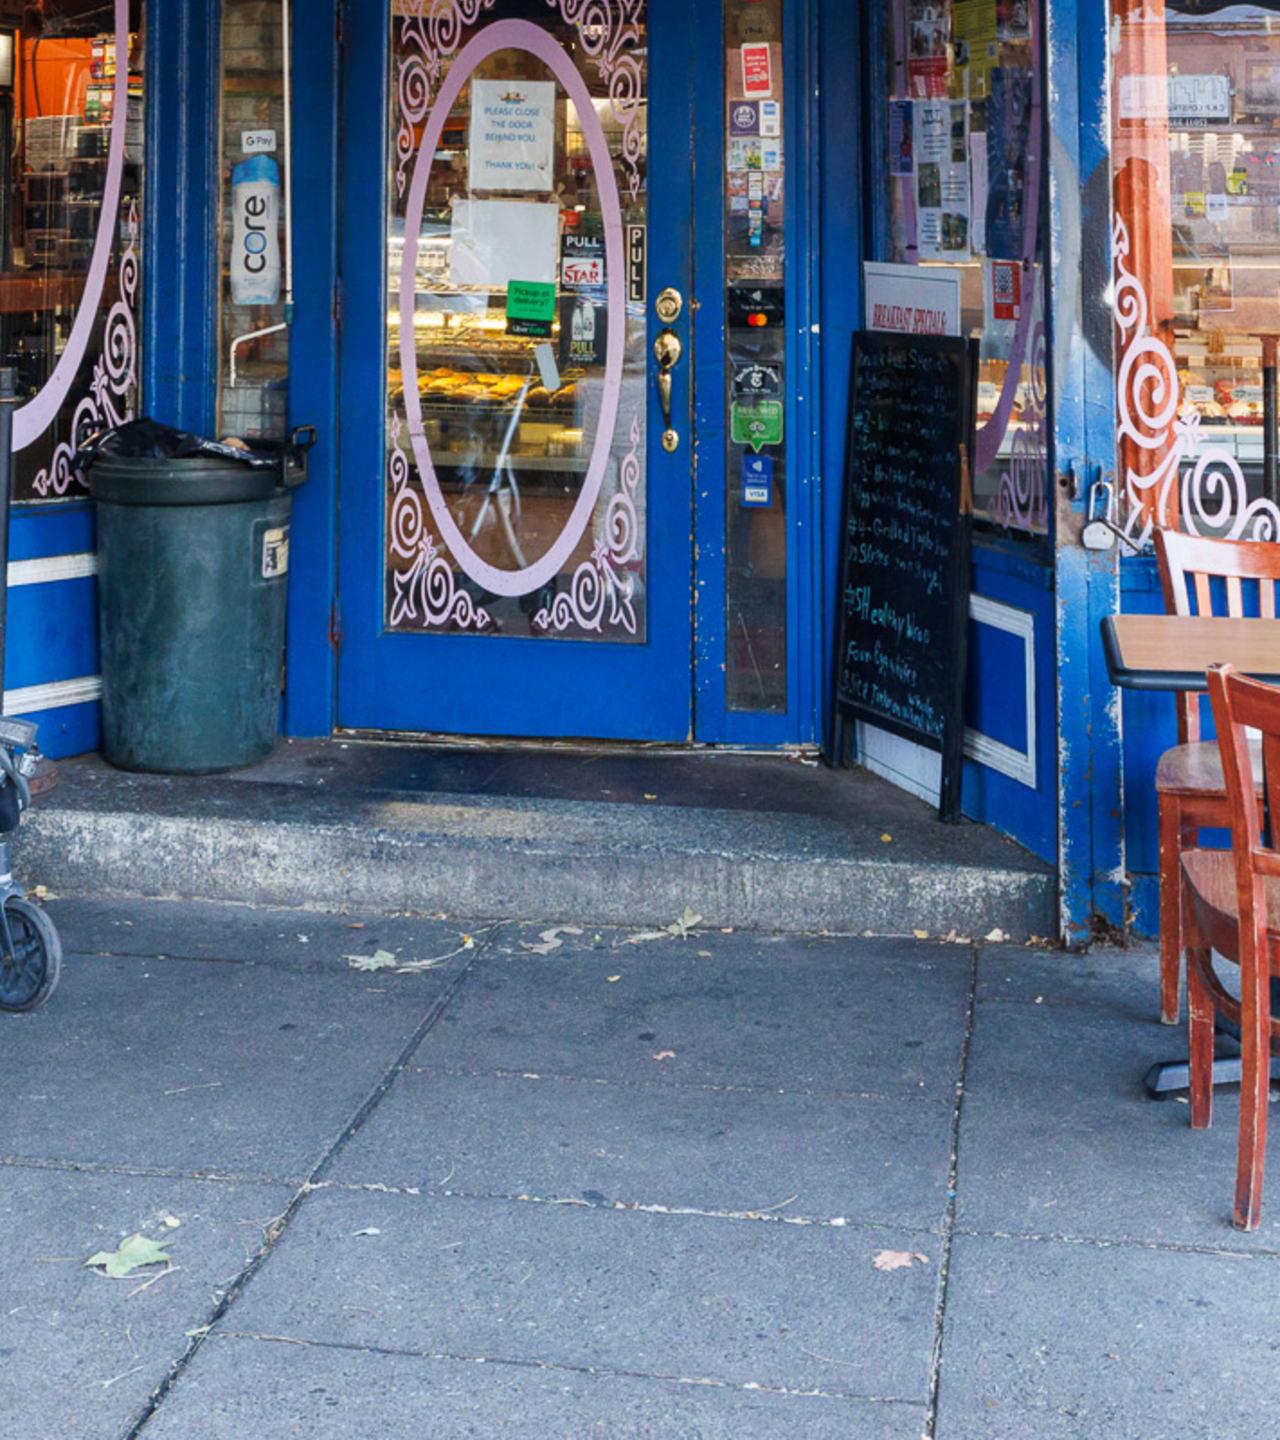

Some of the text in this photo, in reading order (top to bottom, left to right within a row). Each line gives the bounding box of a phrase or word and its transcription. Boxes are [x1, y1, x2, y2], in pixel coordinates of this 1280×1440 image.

[244, 194, 267, 274] core
[565, 235, 601, 249] PULL
[631, 228, 643, 300] PULL
[564, 269, 600, 284] STAR
[569, 340, 597, 356] PULL
